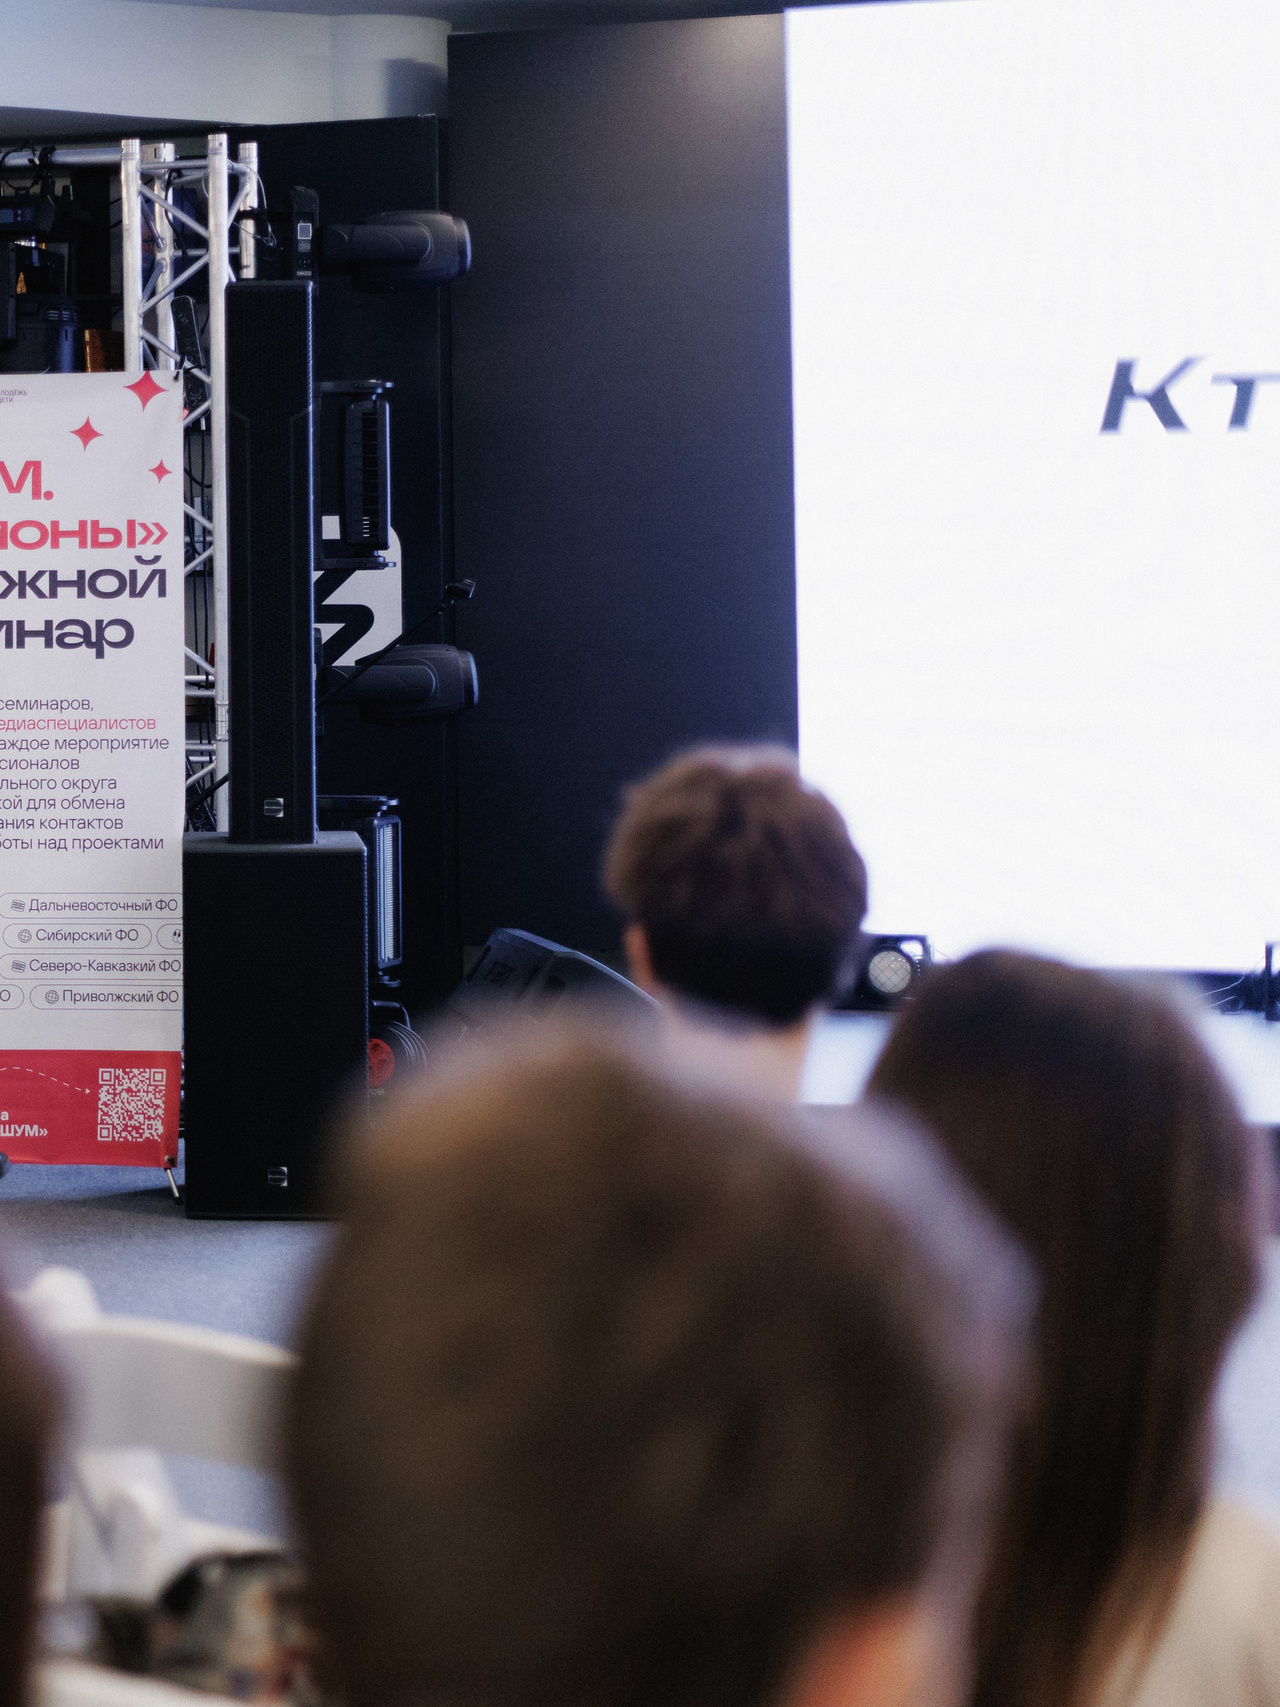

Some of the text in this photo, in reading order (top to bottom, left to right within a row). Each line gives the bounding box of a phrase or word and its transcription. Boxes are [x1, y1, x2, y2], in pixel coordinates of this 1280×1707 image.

[55, 738, 170, 753] мероприятие
[61, 778, 117, 793] округа
[26, 798, 57, 811] для
[61, 793, 126, 809] обмена
[40, 817, 124, 829] контактов
[38, 838, 68, 851] над
[72, 837, 164, 853] проектами
[29, 898, 178, 912] Дальневосточный ФО
[36, 928, 139, 944] Сибирский ФО
[30, 958, 182, 974] Северо-Кавказкий ФО
[63, 989, 180, 1004] Приволжский ФО
